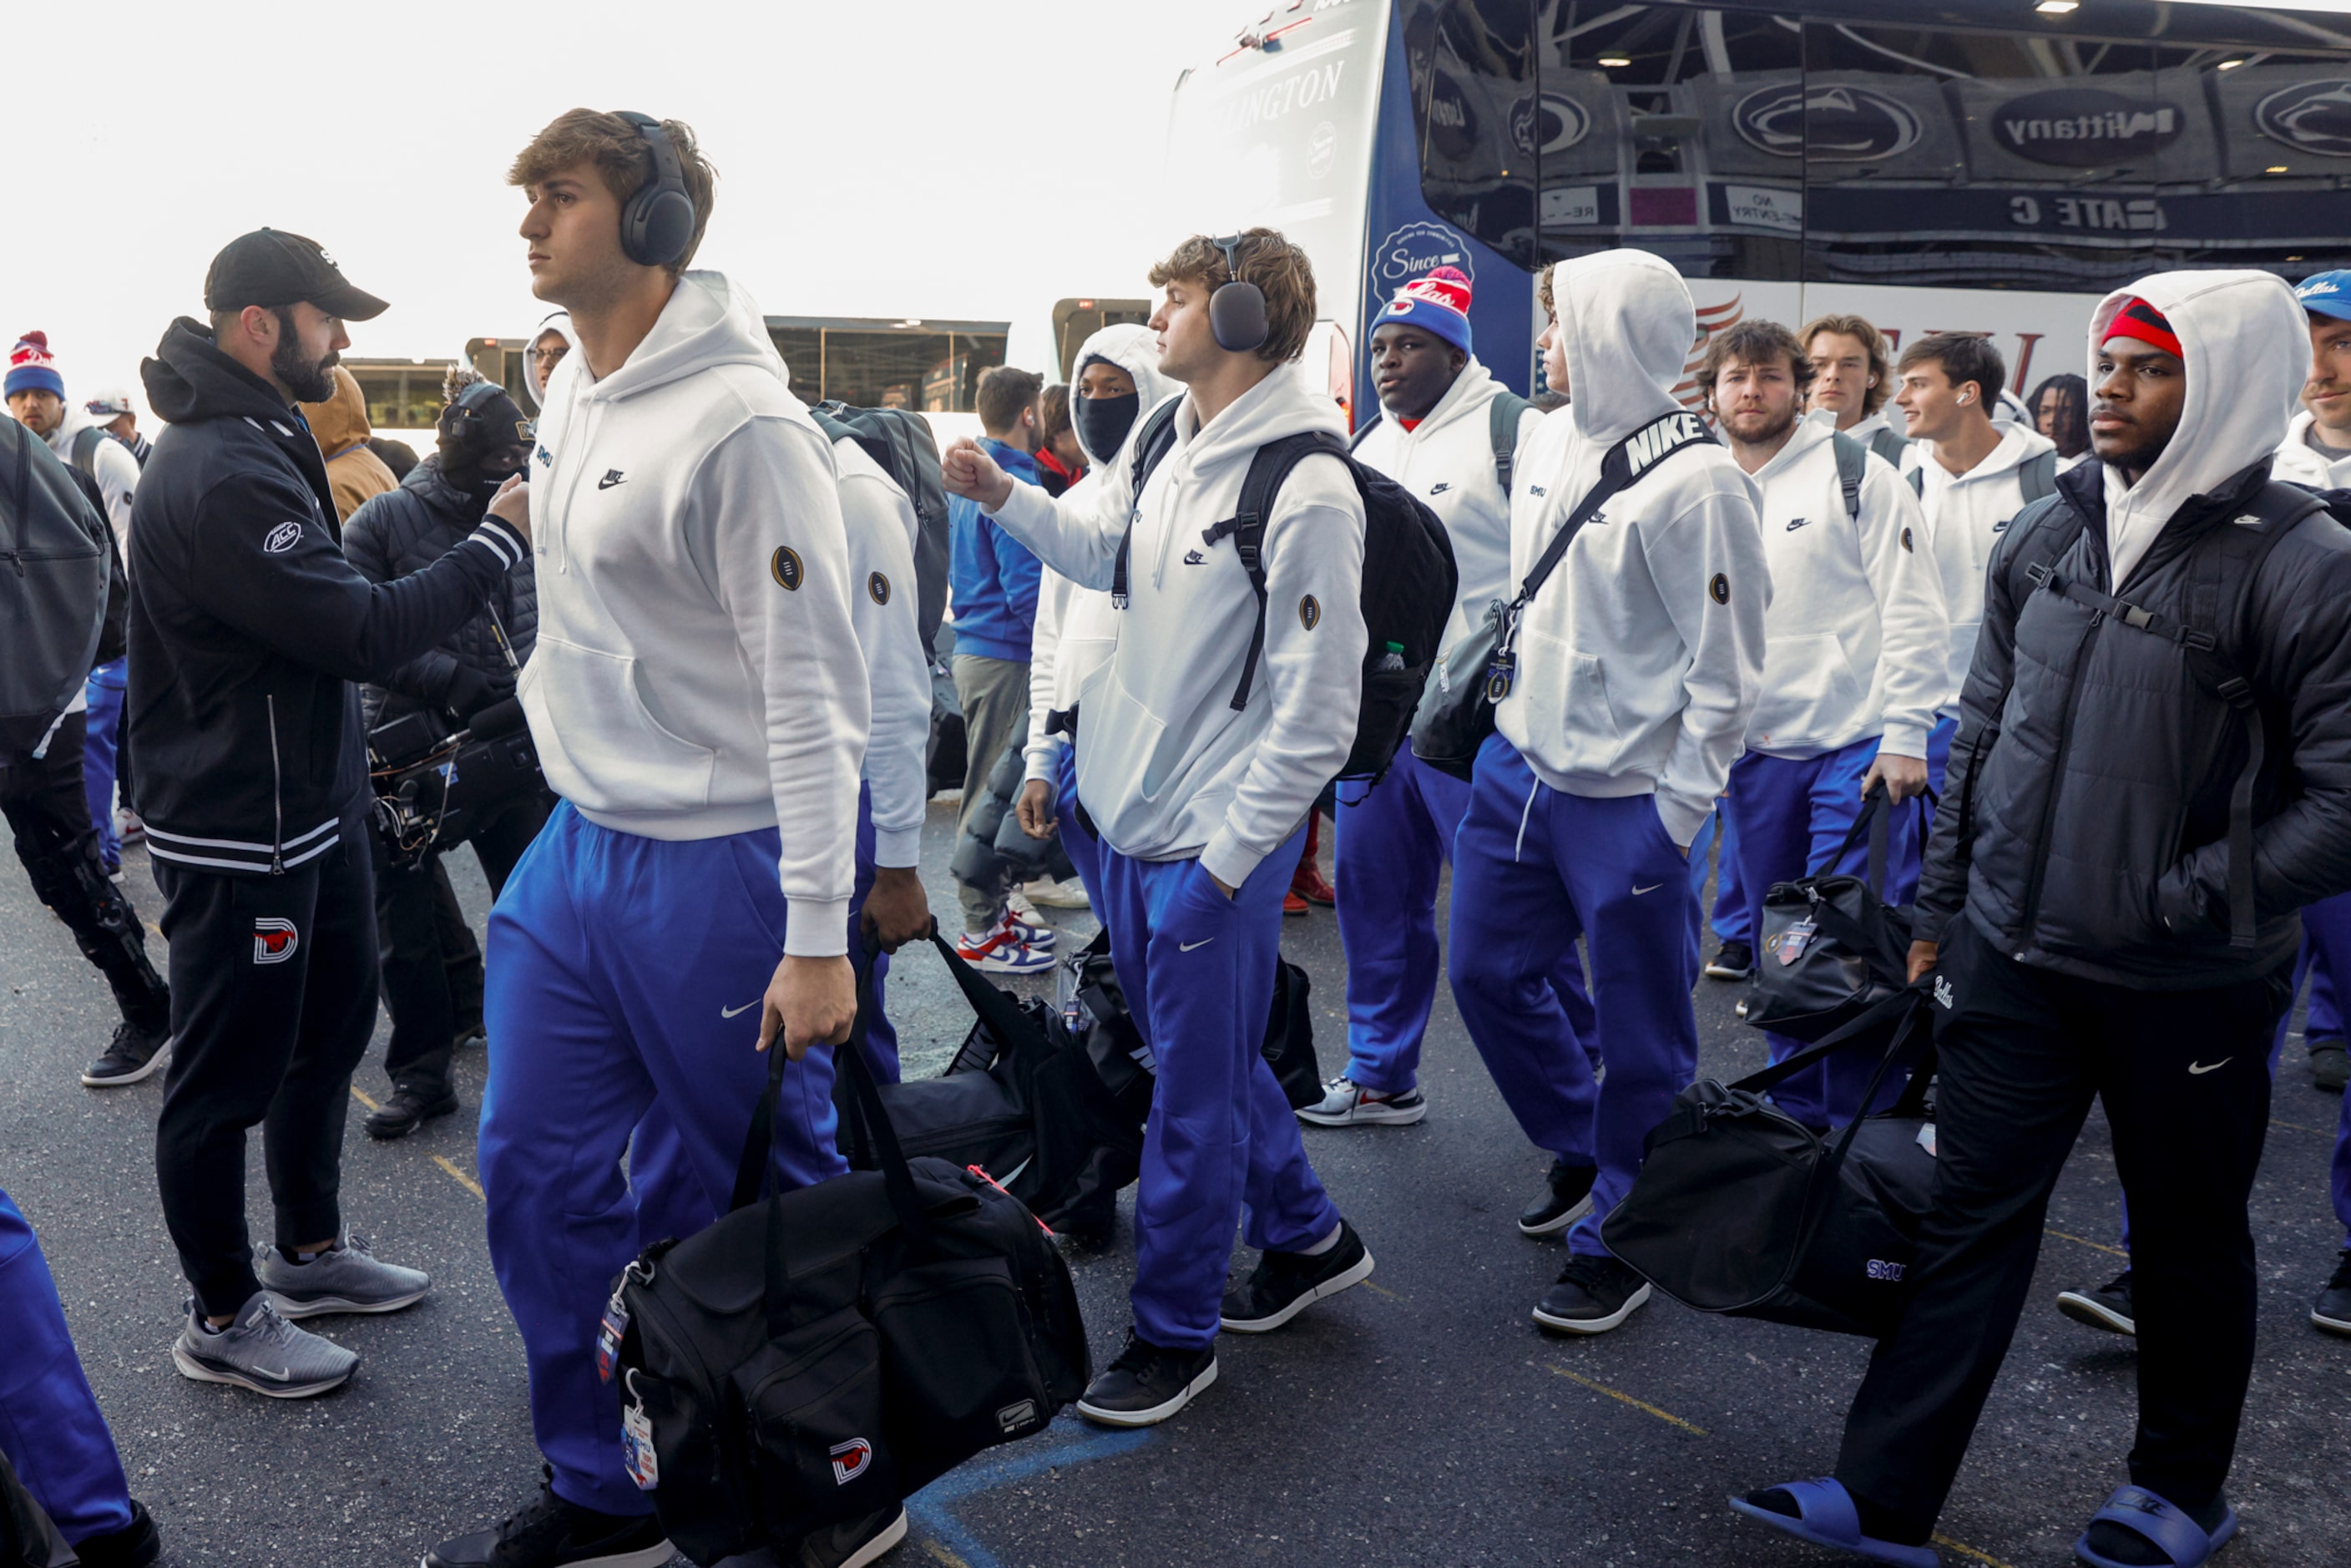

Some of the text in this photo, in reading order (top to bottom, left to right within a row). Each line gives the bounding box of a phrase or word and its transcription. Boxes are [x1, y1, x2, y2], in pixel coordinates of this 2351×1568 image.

[1383, 248, 1440, 279] Since
[1625, 412, 1704, 474] NIKE
[1529, 485, 1547, 498] SMU
[271, 529, 297, 549] ACC
[1934, 975, 1954, 1009] Dallas
[1866, 1258, 1906, 1282] SMU
